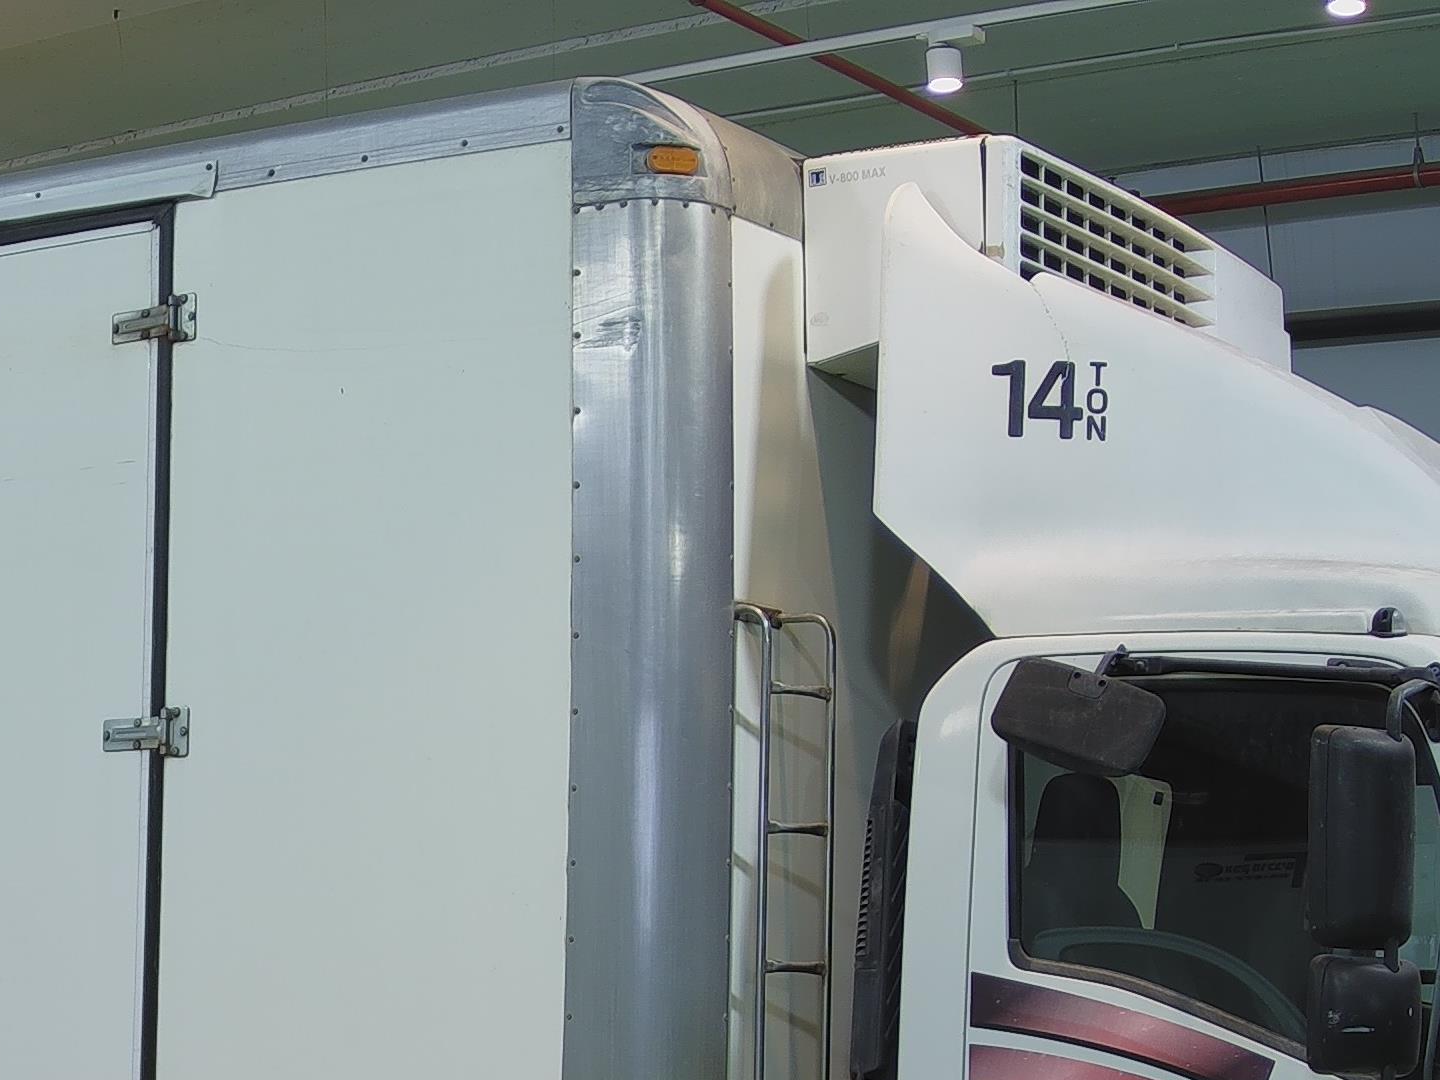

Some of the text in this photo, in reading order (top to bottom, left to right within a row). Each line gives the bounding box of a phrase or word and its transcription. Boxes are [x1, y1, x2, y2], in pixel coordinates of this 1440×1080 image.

[829, 170, 859, 185] V-800
[861, 166, 886, 180] MAX
[992, 360, 1083, 440] 14
[1087, 361, 1108, 441] TON
